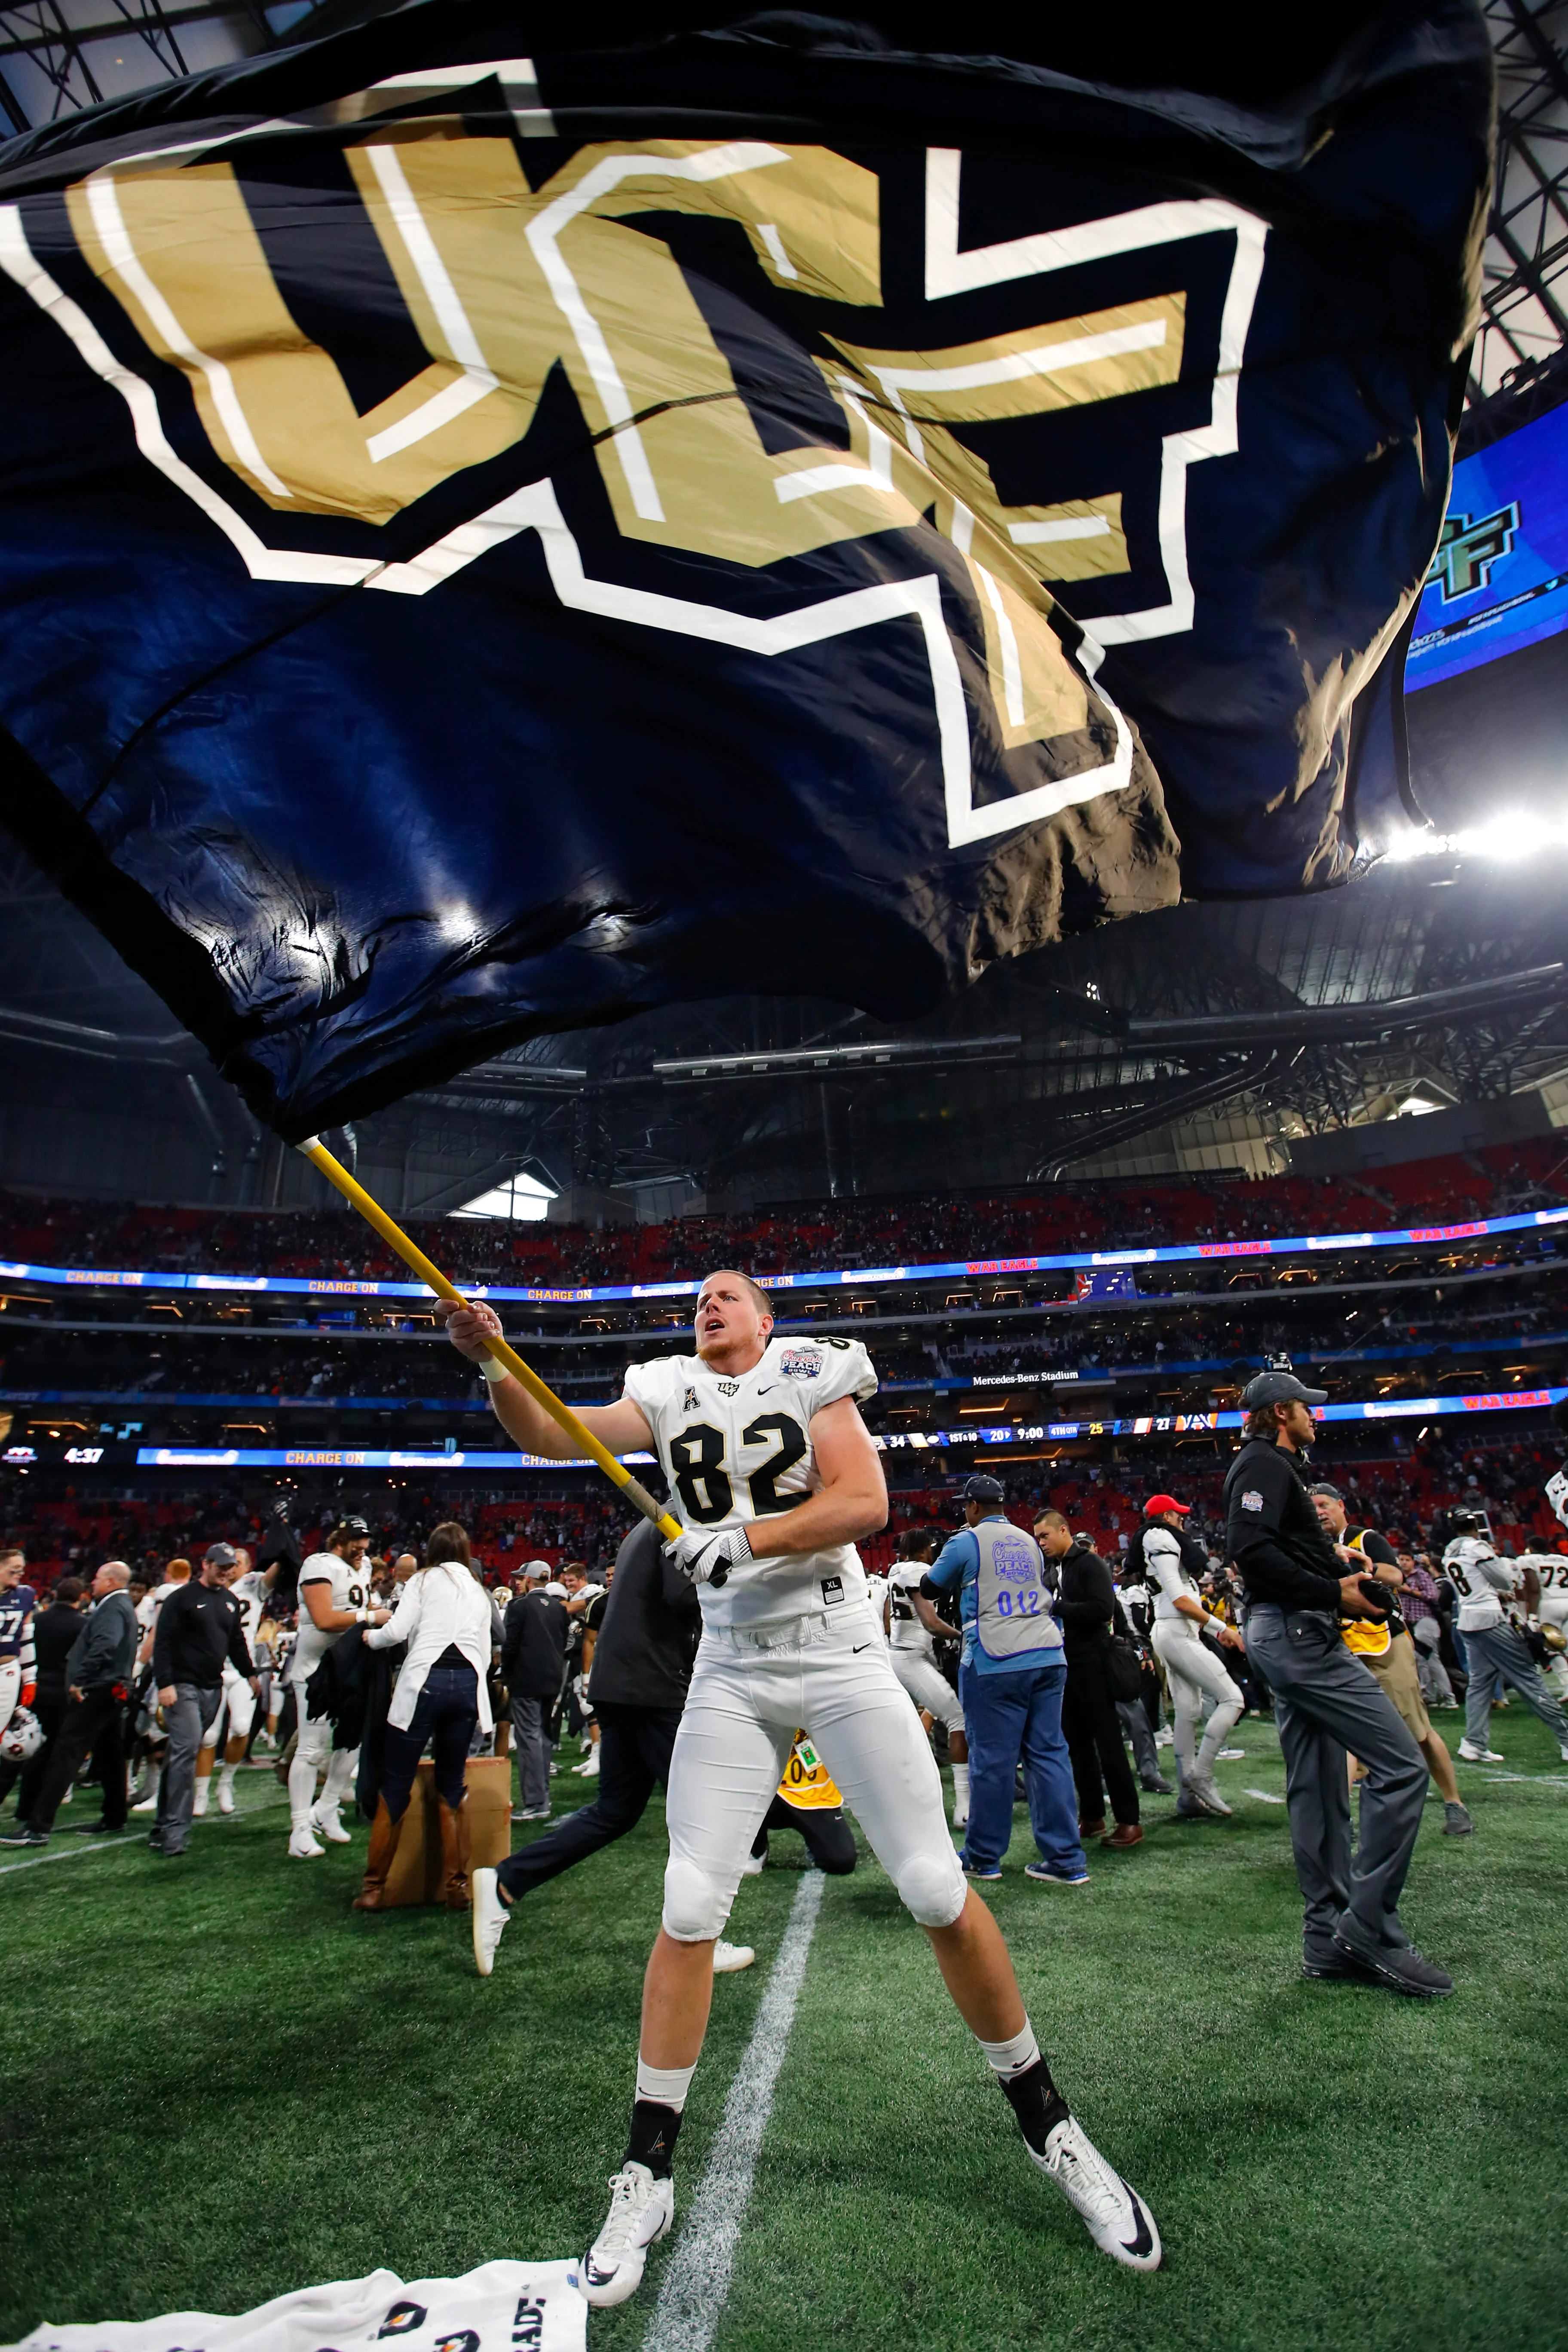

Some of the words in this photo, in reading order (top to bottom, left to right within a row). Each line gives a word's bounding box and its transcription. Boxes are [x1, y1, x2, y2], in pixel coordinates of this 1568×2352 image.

[60, 114, 1188, 750] UCF
[1409, 1228, 1442, 1242] WAR
[1443, 1221, 1488, 1239] EAGLE
[1198, 1243, 1232, 1257] WAR
[1233, 1240, 1272, 1253] EAGLE
[966, 1262, 998, 1274] WAR
[1000, 1258, 1038, 1271] EAGLE
[66, 1271, 119, 1283] CHARGE
[122, 1273, 143, 1284] ON
[778, 1275, 794, 1286] ON
[309, 1280, 358, 1292] CHARGE
[361, 1282, 379, 1293] ON
[528, 1289, 574, 1300] CHARGE
[576, 1289, 592, 1299] ON
[781, 1361, 821, 1372] PEACH
[973, 1374, 1040, 1386] Mercedes-Benz
[1041, 1370, 1079, 1381] Stadium
[717, 1382, 740, 1397] UCF
[1461, 1396, 1501, 1410] WAR
[1501, 1391, 1552, 1407] EAGLE
[1089, 1423, 1103, 1435] 25
[1156, 1418, 1170, 1430] 27
[990, 1430, 1004, 1441] 20
[1017, 1427, 1044, 1439] 9:00
[1051, 1428, 1066, 1436] 4TH
[889, 1435, 905, 1448] 34
[64, 1448, 104, 1463] 4:37
[286, 1452, 342, 1464] CHARGE
[345, 1452, 365, 1464] ON
[669, 1412, 815, 1525] 82
[996, 1561, 1035, 1575] PEACH
[1540, 1566, 1568, 1588] 72
[827, 1580, 838, 1589] XL
[998, 1590, 1041, 1617] 012
